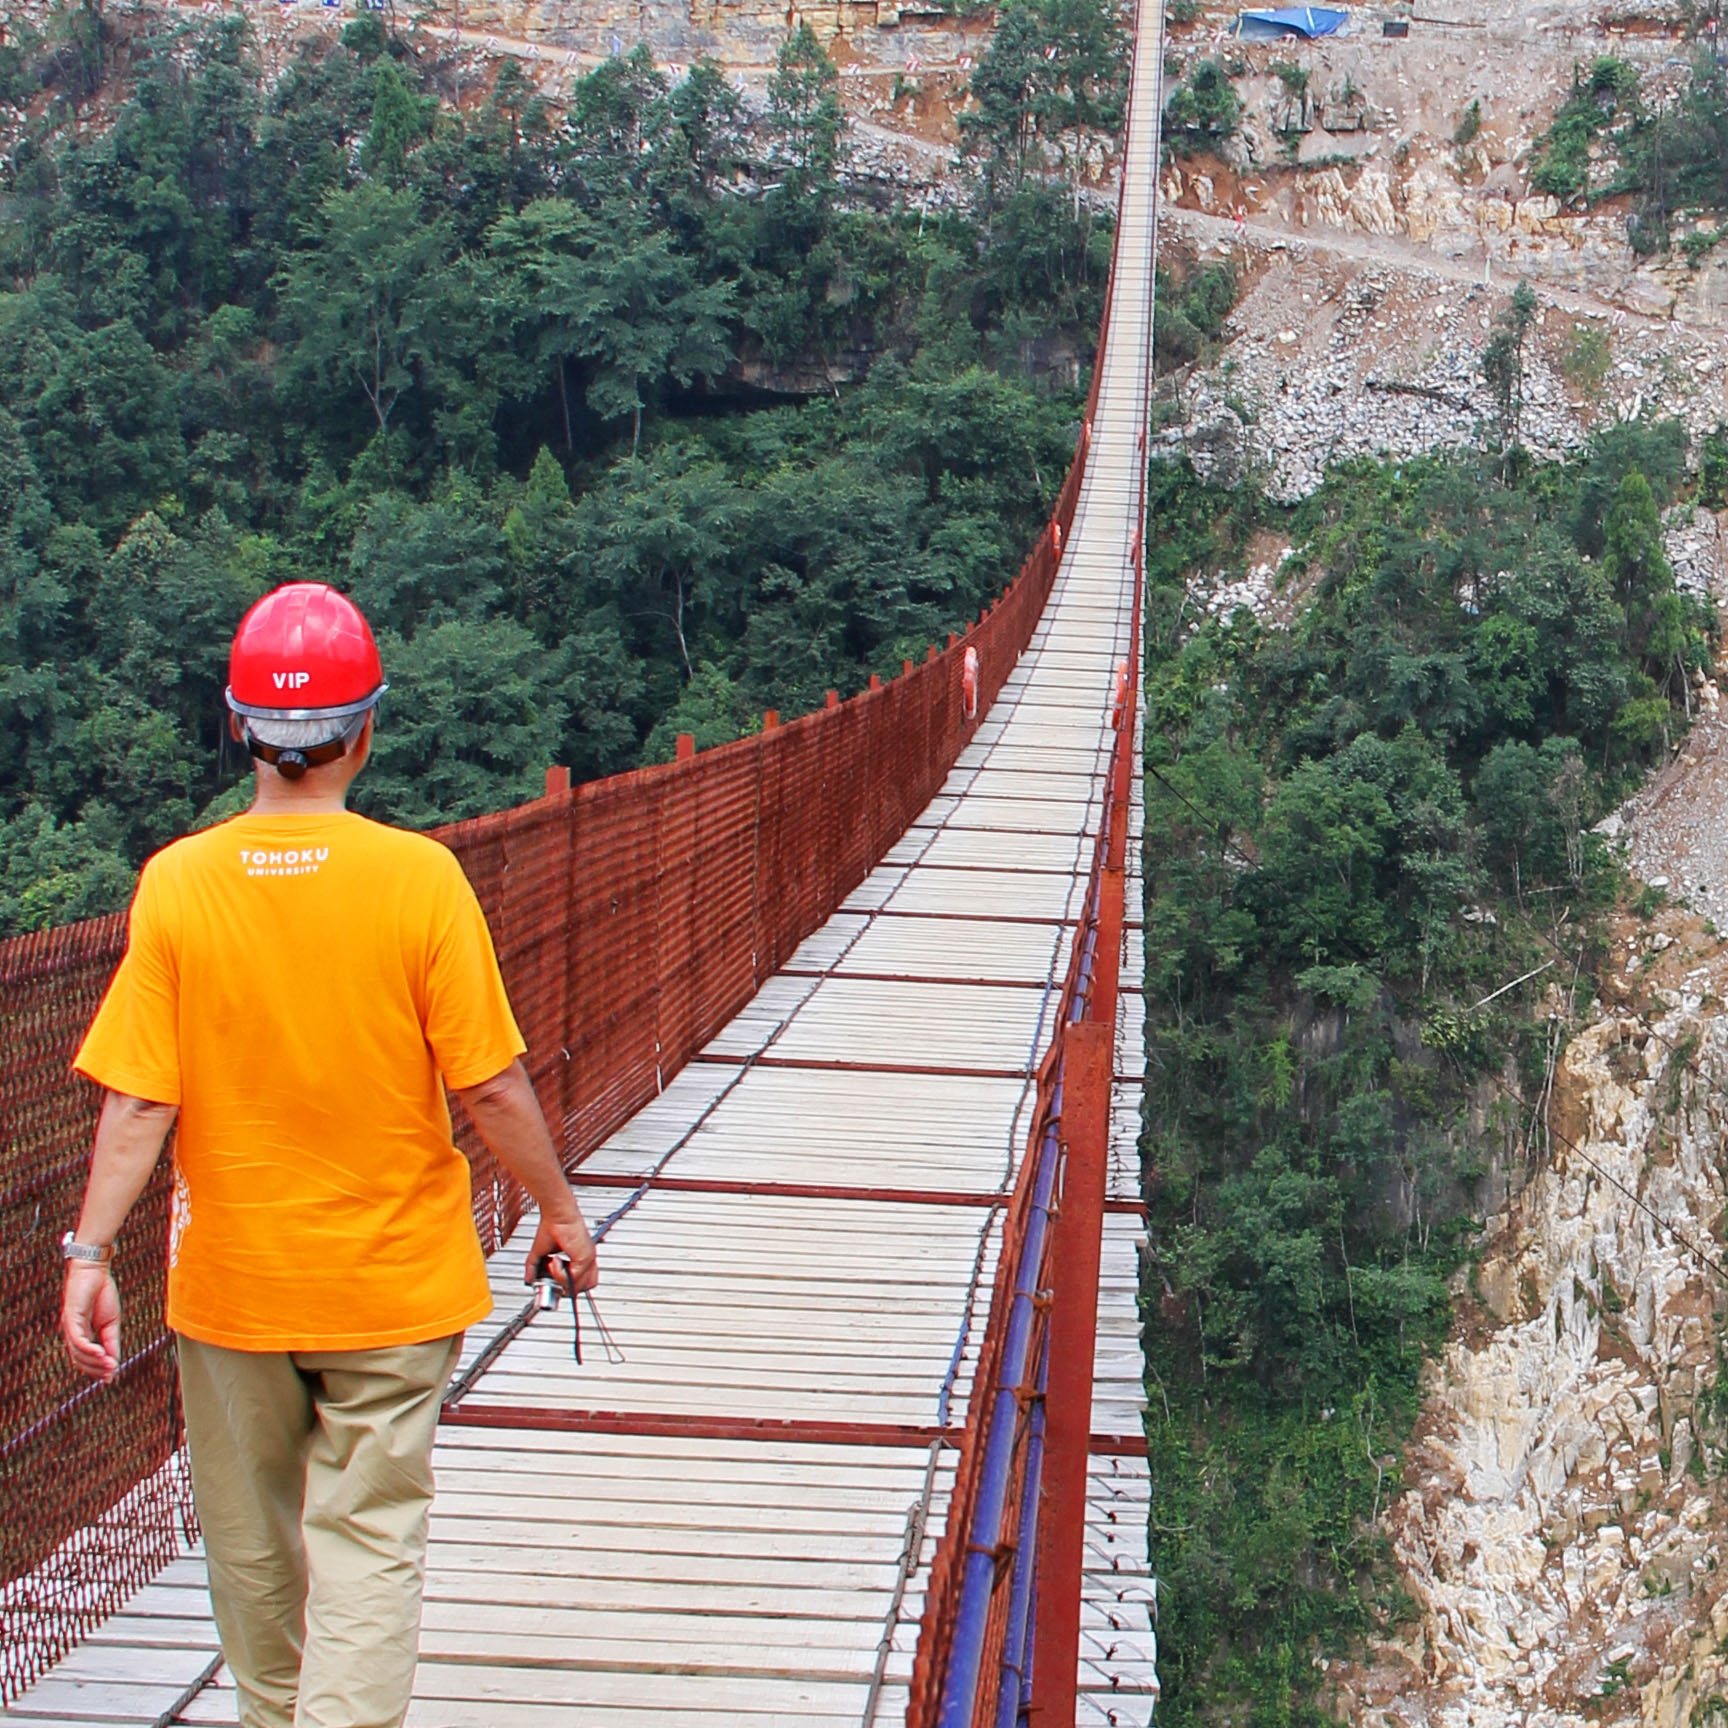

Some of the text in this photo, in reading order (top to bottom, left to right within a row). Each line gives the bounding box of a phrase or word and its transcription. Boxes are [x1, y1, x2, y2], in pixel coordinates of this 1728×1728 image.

[272, 672, 310, 689] VIP
[240, 847, 328, 865] TOHOKU
[247, 865, 319, 876] UNIVERSITY
